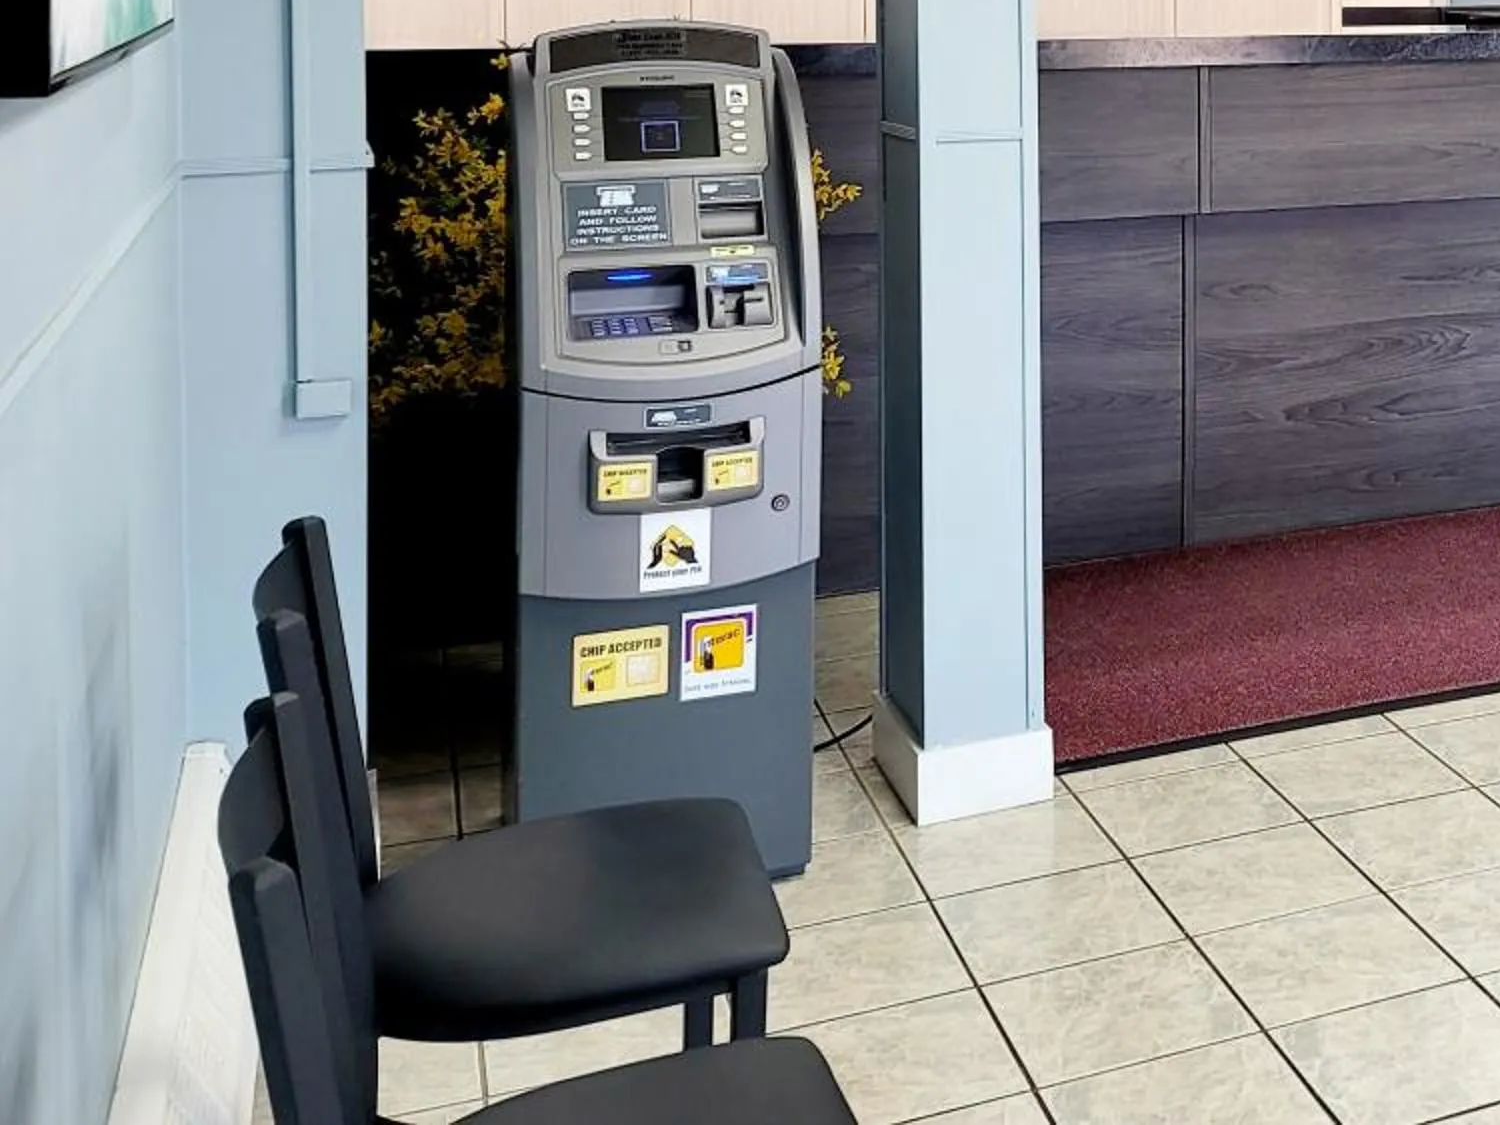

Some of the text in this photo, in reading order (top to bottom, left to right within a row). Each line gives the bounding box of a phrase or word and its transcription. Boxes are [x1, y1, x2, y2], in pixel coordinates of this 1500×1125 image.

[624, 206, 657, 214] CARD
[579, 215, 657, 226] AND FOLLOW
[576, 224, 659, 236] INSTRUCTIONS
[593, 236, 615, 244] THE
[621, 233, 667, 242] SCREEN
[580, 637, 662, 658] CHIP ACCEPTED
